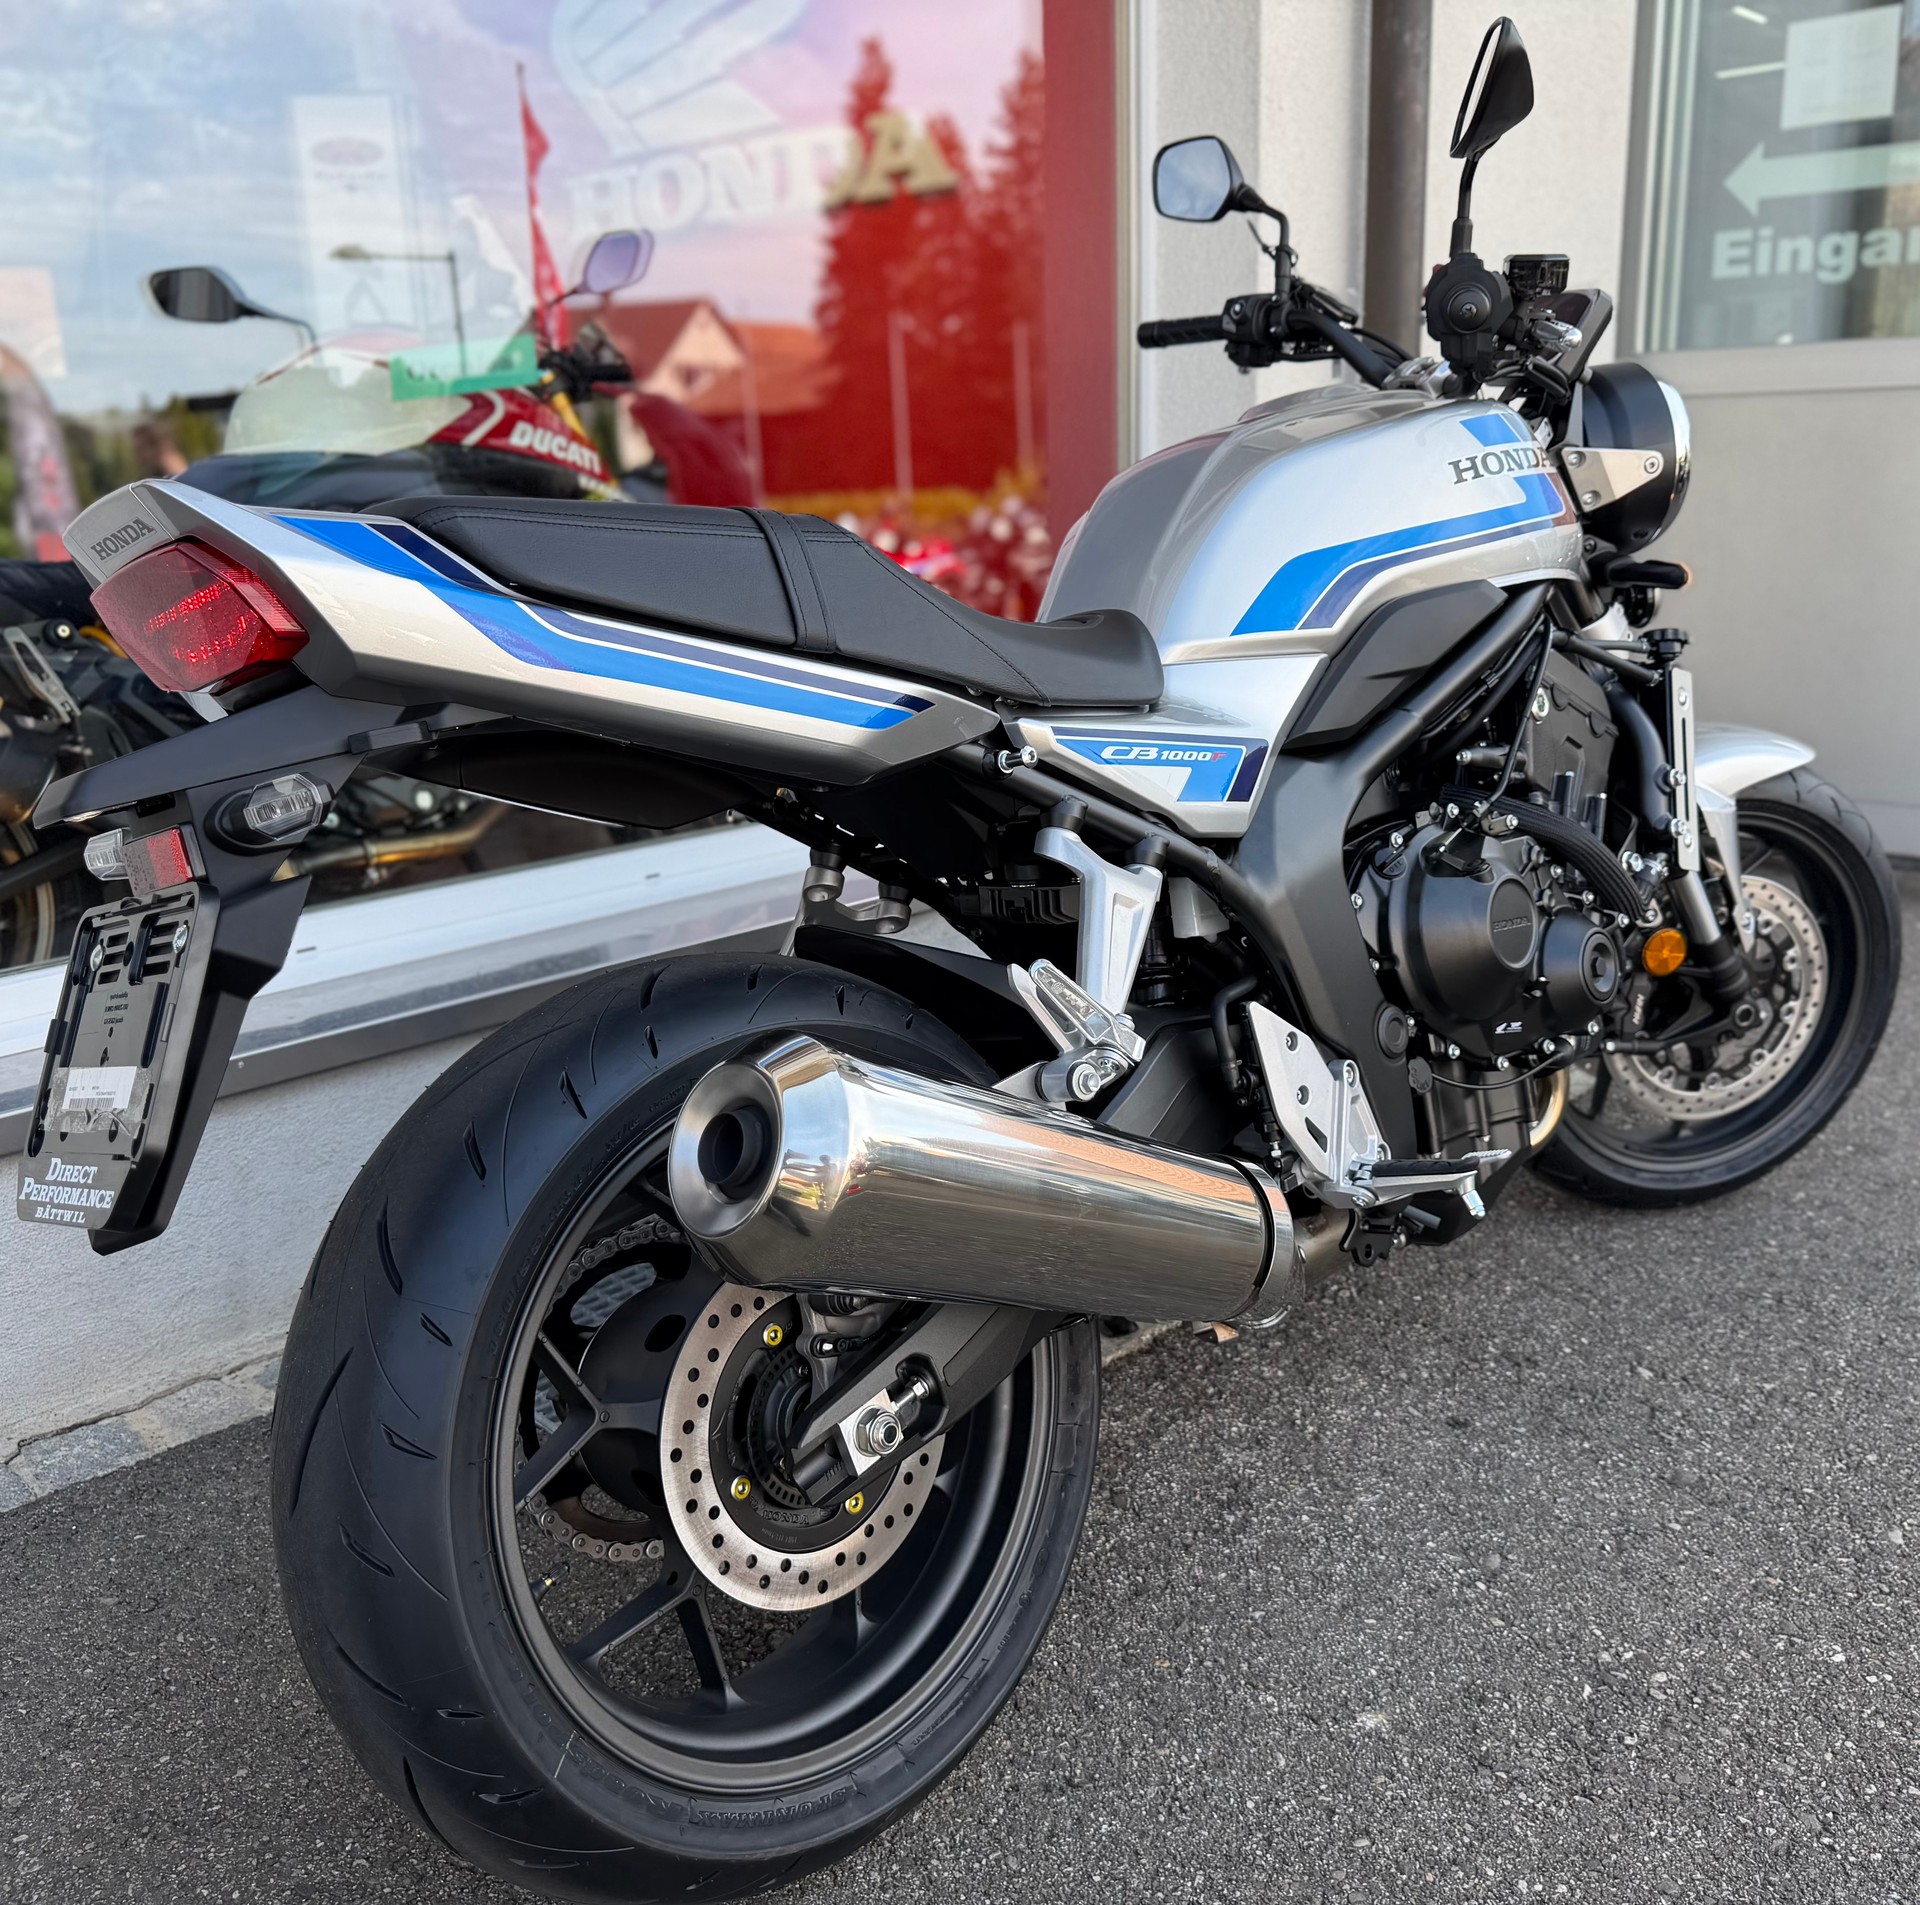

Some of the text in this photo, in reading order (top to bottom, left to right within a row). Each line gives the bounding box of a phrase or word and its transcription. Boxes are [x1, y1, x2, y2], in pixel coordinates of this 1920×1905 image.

[567, 109, 957, 236] HONDA
[509, 420, 602, 475] DUCATI
[1448, 447, 1555, 485] HONDA
[90, 518, 155, 561] HONDA
[1493, 915, 1532, 933] HONDA
[45, 1157, 98, 1184] DIRECT
[18, 1177, 115, 1209] PERFORMANCE
[35, 1204, 86, 1224] BÄTTWIL
[762, 1509, 809, 1525] HONDA
[695, 1787, 847, 1829] SPORTMAX
